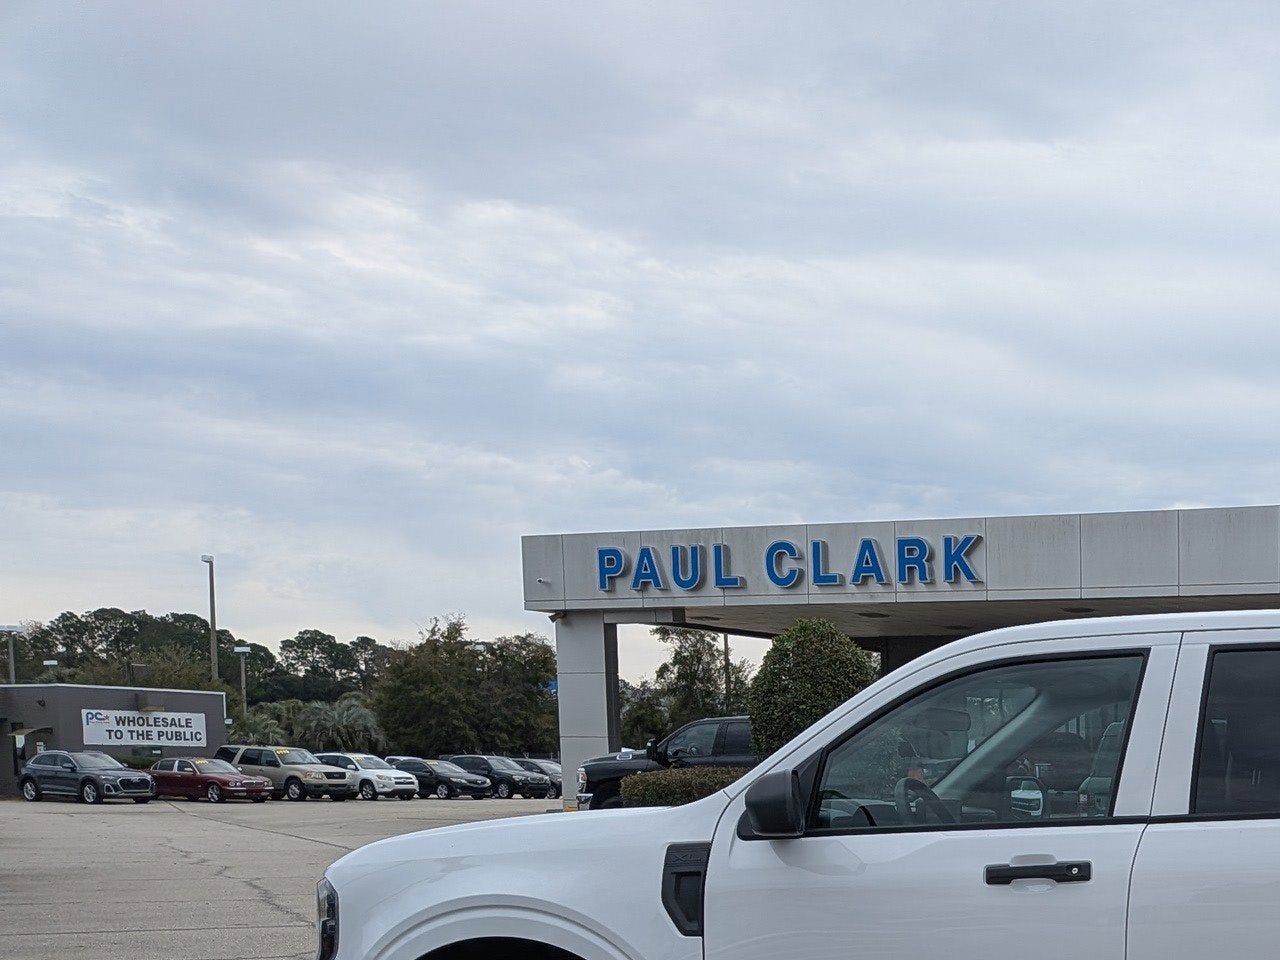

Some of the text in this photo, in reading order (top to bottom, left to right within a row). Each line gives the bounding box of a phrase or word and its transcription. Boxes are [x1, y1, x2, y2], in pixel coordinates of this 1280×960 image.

[597, 534, 983, 591] PAUL CLARK
[114, 715, 193, 728] WHOLESALE
[106, 729, 203, 742] TO THE PUBLIC
